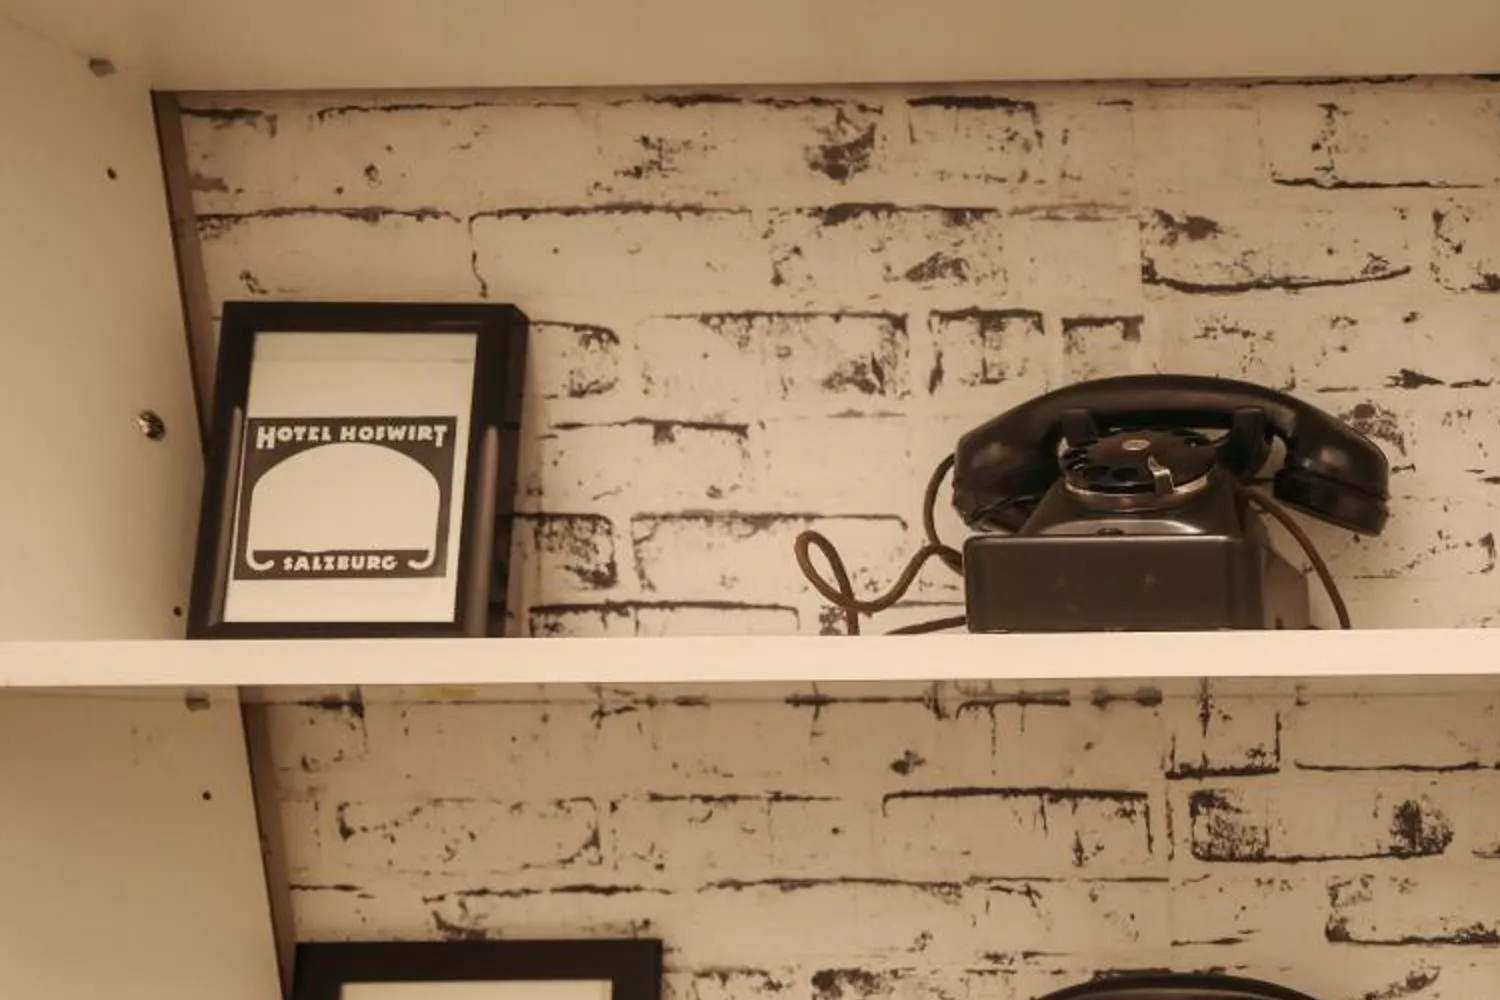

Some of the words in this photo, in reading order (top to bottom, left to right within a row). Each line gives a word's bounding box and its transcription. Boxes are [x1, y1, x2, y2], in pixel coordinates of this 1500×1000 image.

[256, 425, 332, 449] HOTEL
[340, 424, 448, 448] HOFWIRT
[283, 555, 398, 571] SALZBURG
